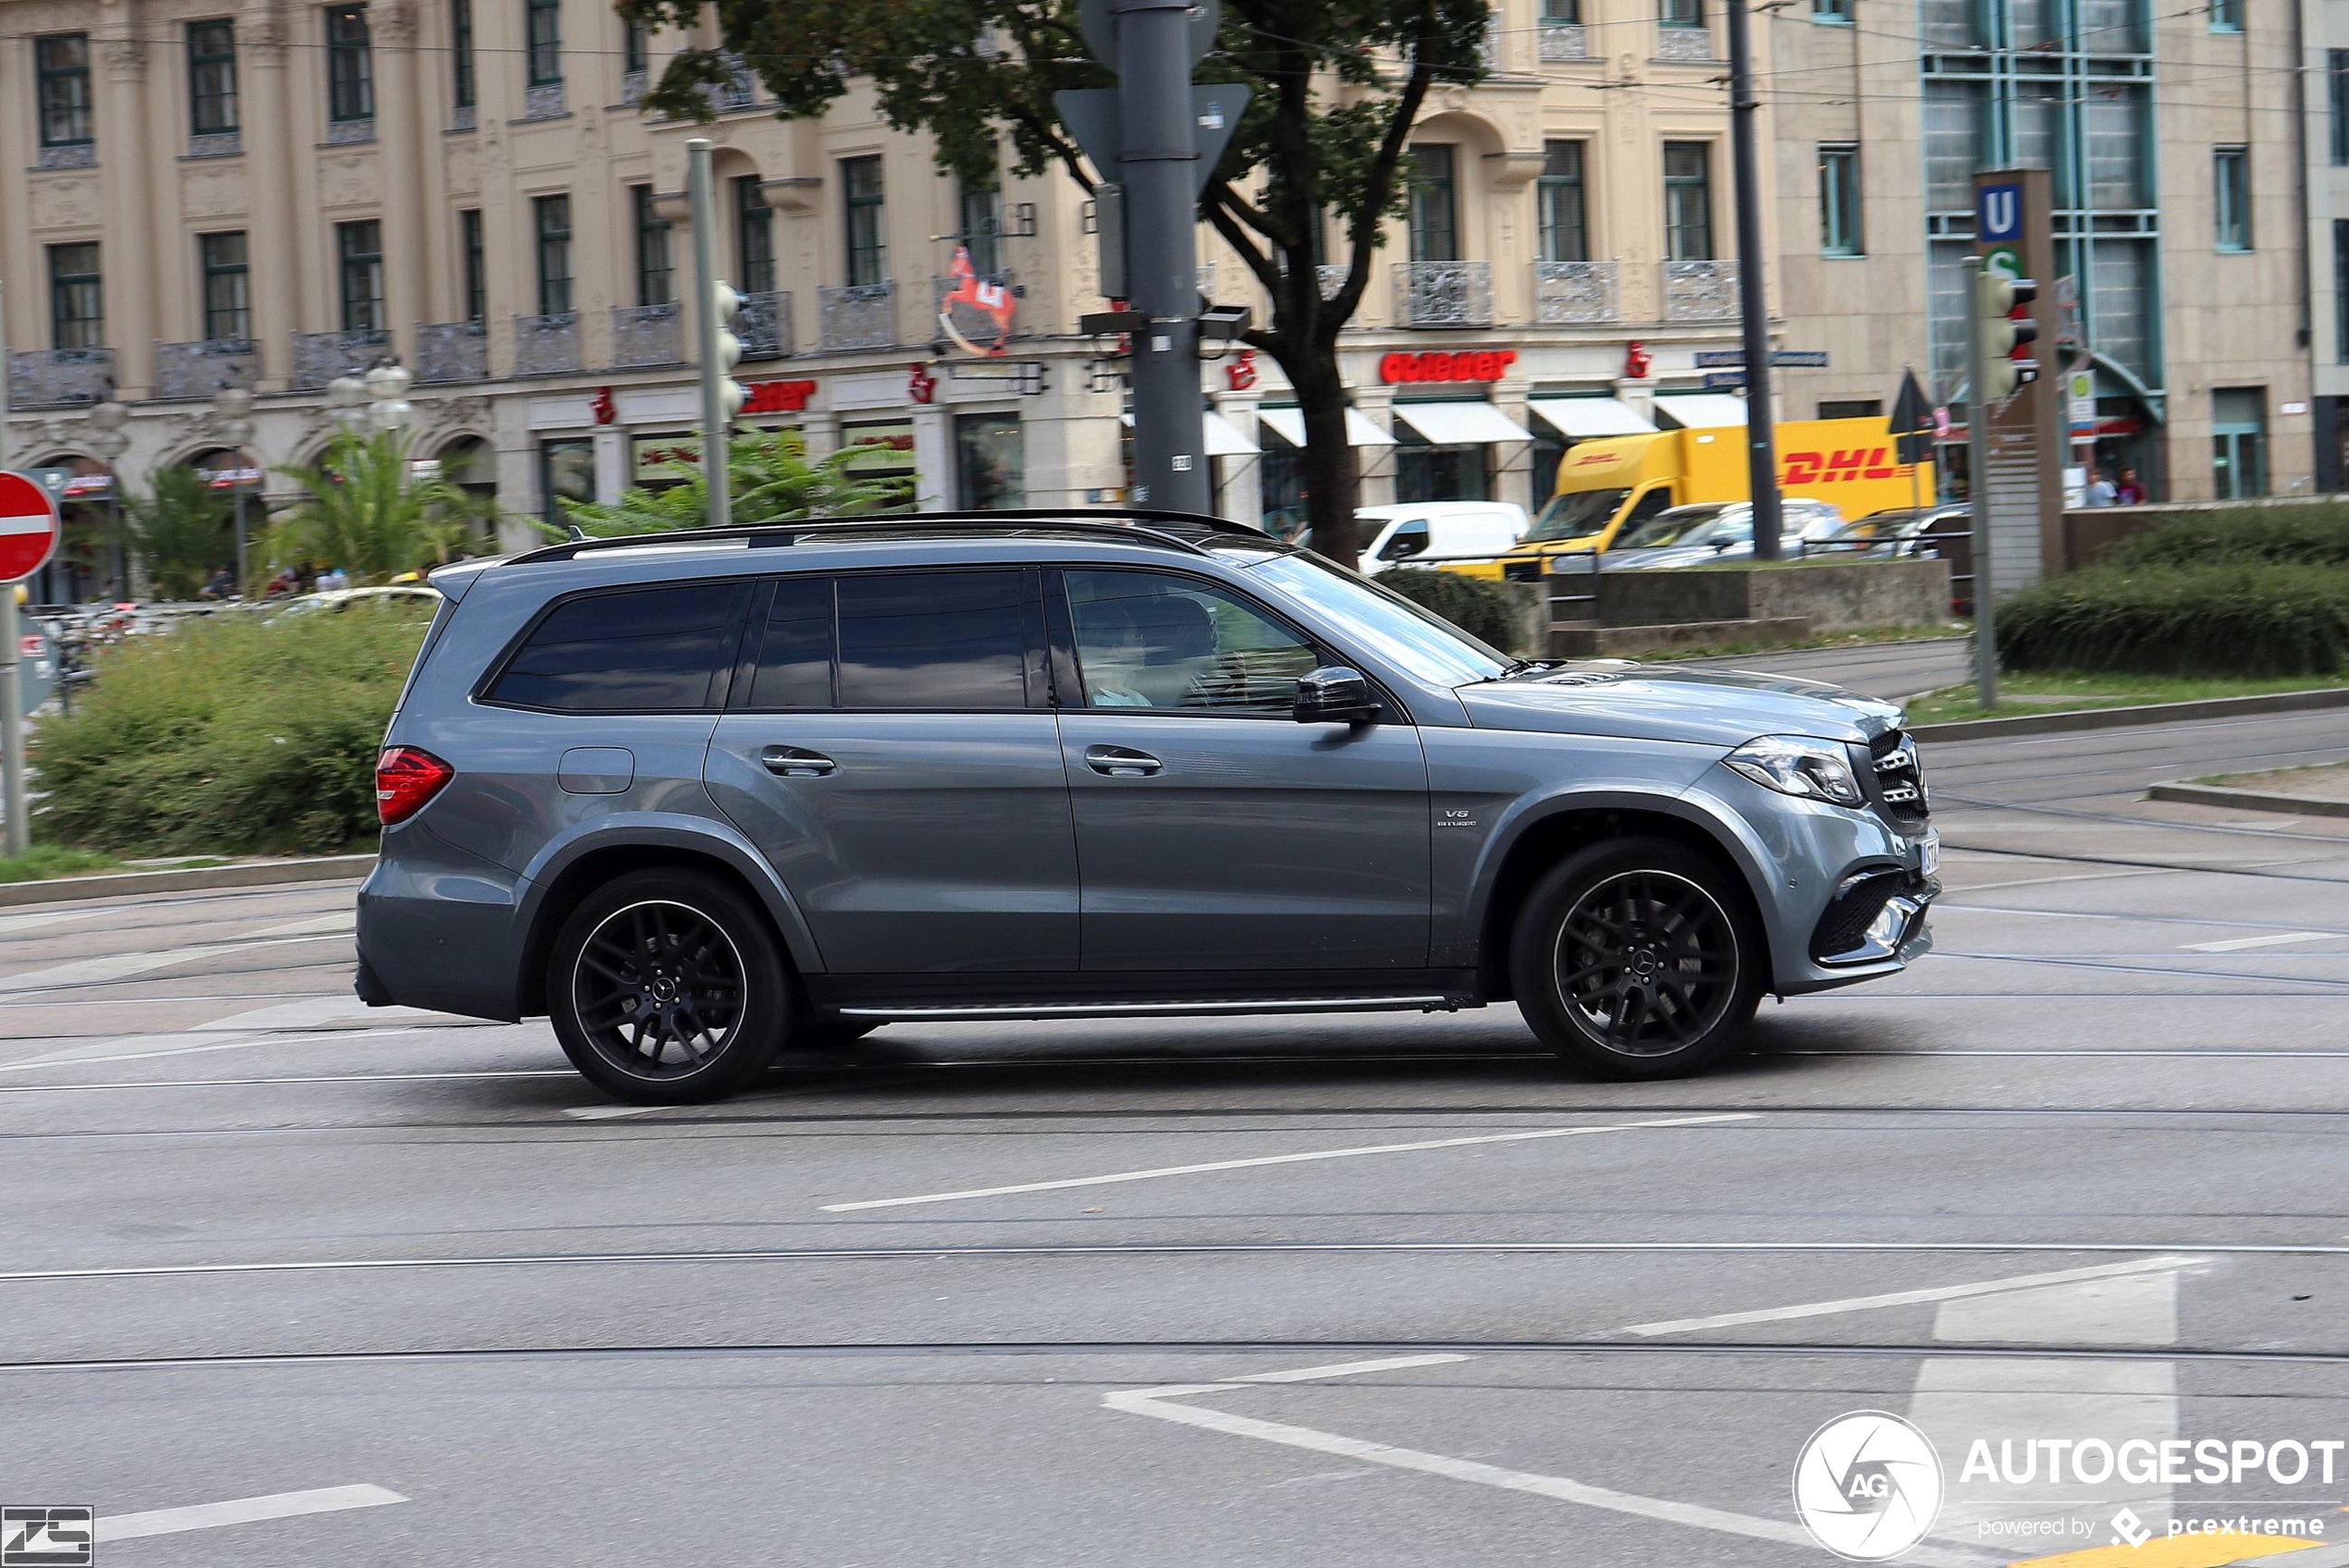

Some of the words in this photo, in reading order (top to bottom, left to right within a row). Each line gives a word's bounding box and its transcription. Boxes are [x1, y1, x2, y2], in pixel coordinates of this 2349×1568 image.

[1986, 190, 2015, 234] U
[1987, 251, 2018, 280] S
[1785, 447, 1896, 484] DHL
